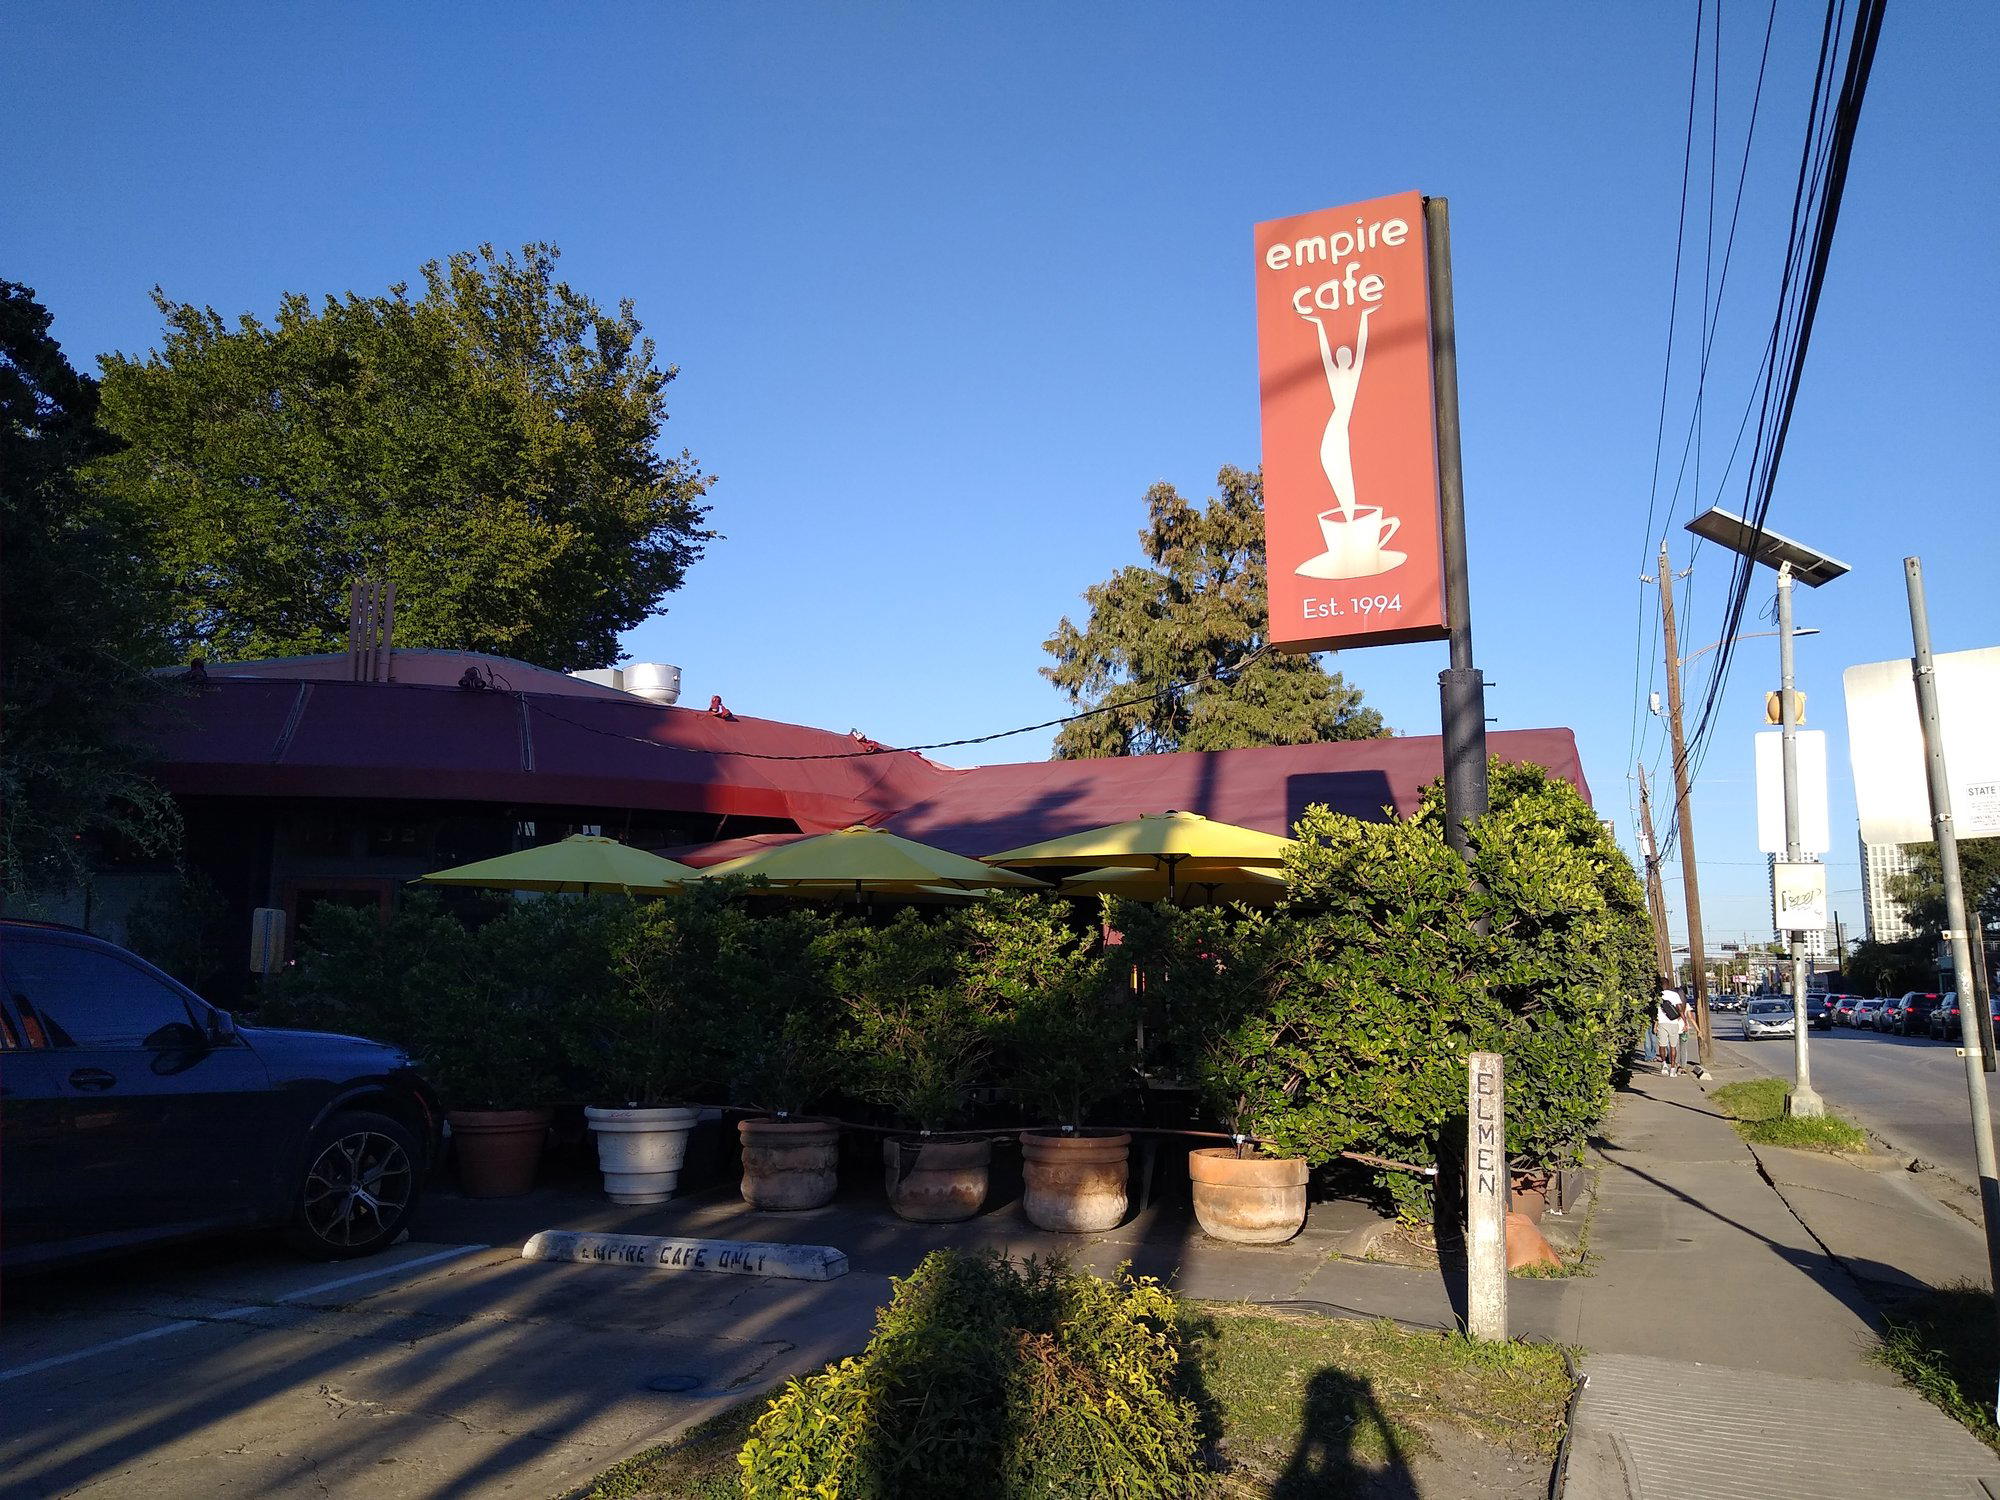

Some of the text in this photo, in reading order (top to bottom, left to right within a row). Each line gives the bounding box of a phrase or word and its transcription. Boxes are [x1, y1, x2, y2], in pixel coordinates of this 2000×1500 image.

[1265, 216, 1409, 271] empire
[1292, 261, 1385, 315] cafe
[1303, 593, 1402, 619] Est. 1994
[1968, 785, 1996, 797] STATE
[1477, 1072, 1495, 1196] ELMEN
[659, 1246, 708, 1268] CAFE
[718, 1250, 766, 1271] ONLY
